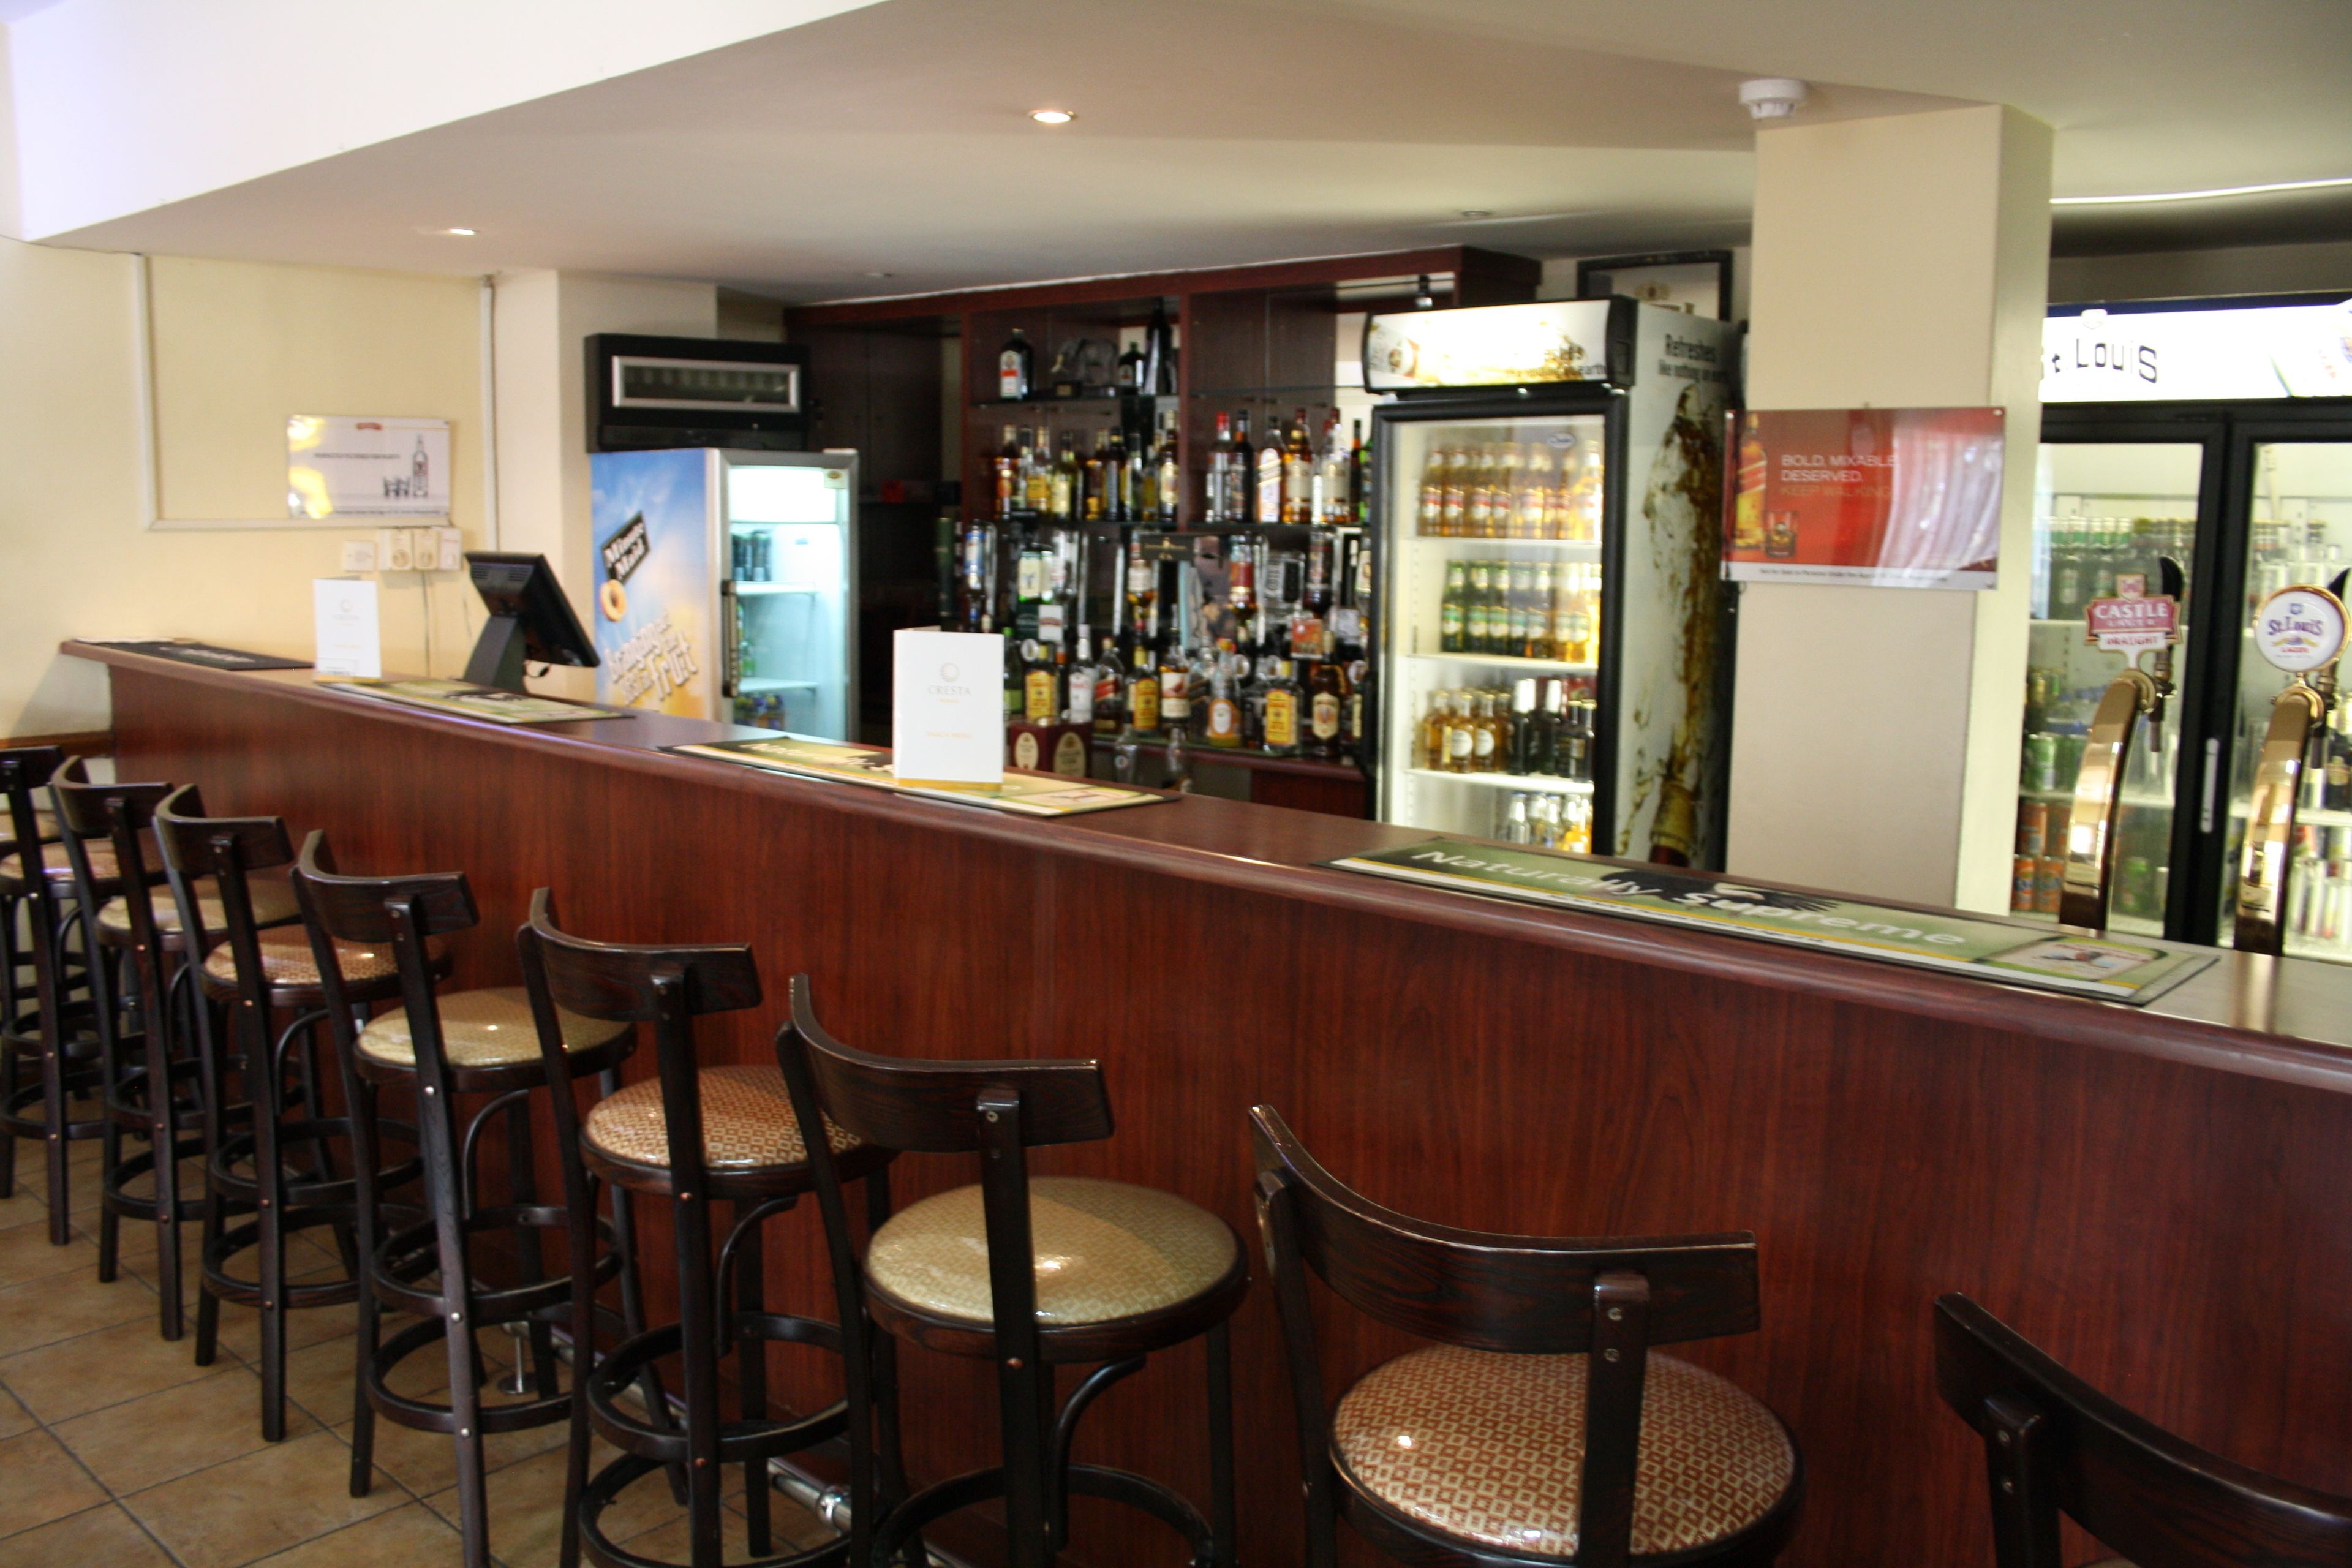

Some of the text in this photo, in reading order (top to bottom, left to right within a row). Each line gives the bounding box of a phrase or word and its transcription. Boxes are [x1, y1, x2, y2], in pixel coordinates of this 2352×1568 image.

[2094, 603, 2169, 619] CASTLE
[927, 685, 971, 696] CRESTA
[1411, 851, 1662, 896] Naturally
[1672, 892, 1966, 945] Supreme
